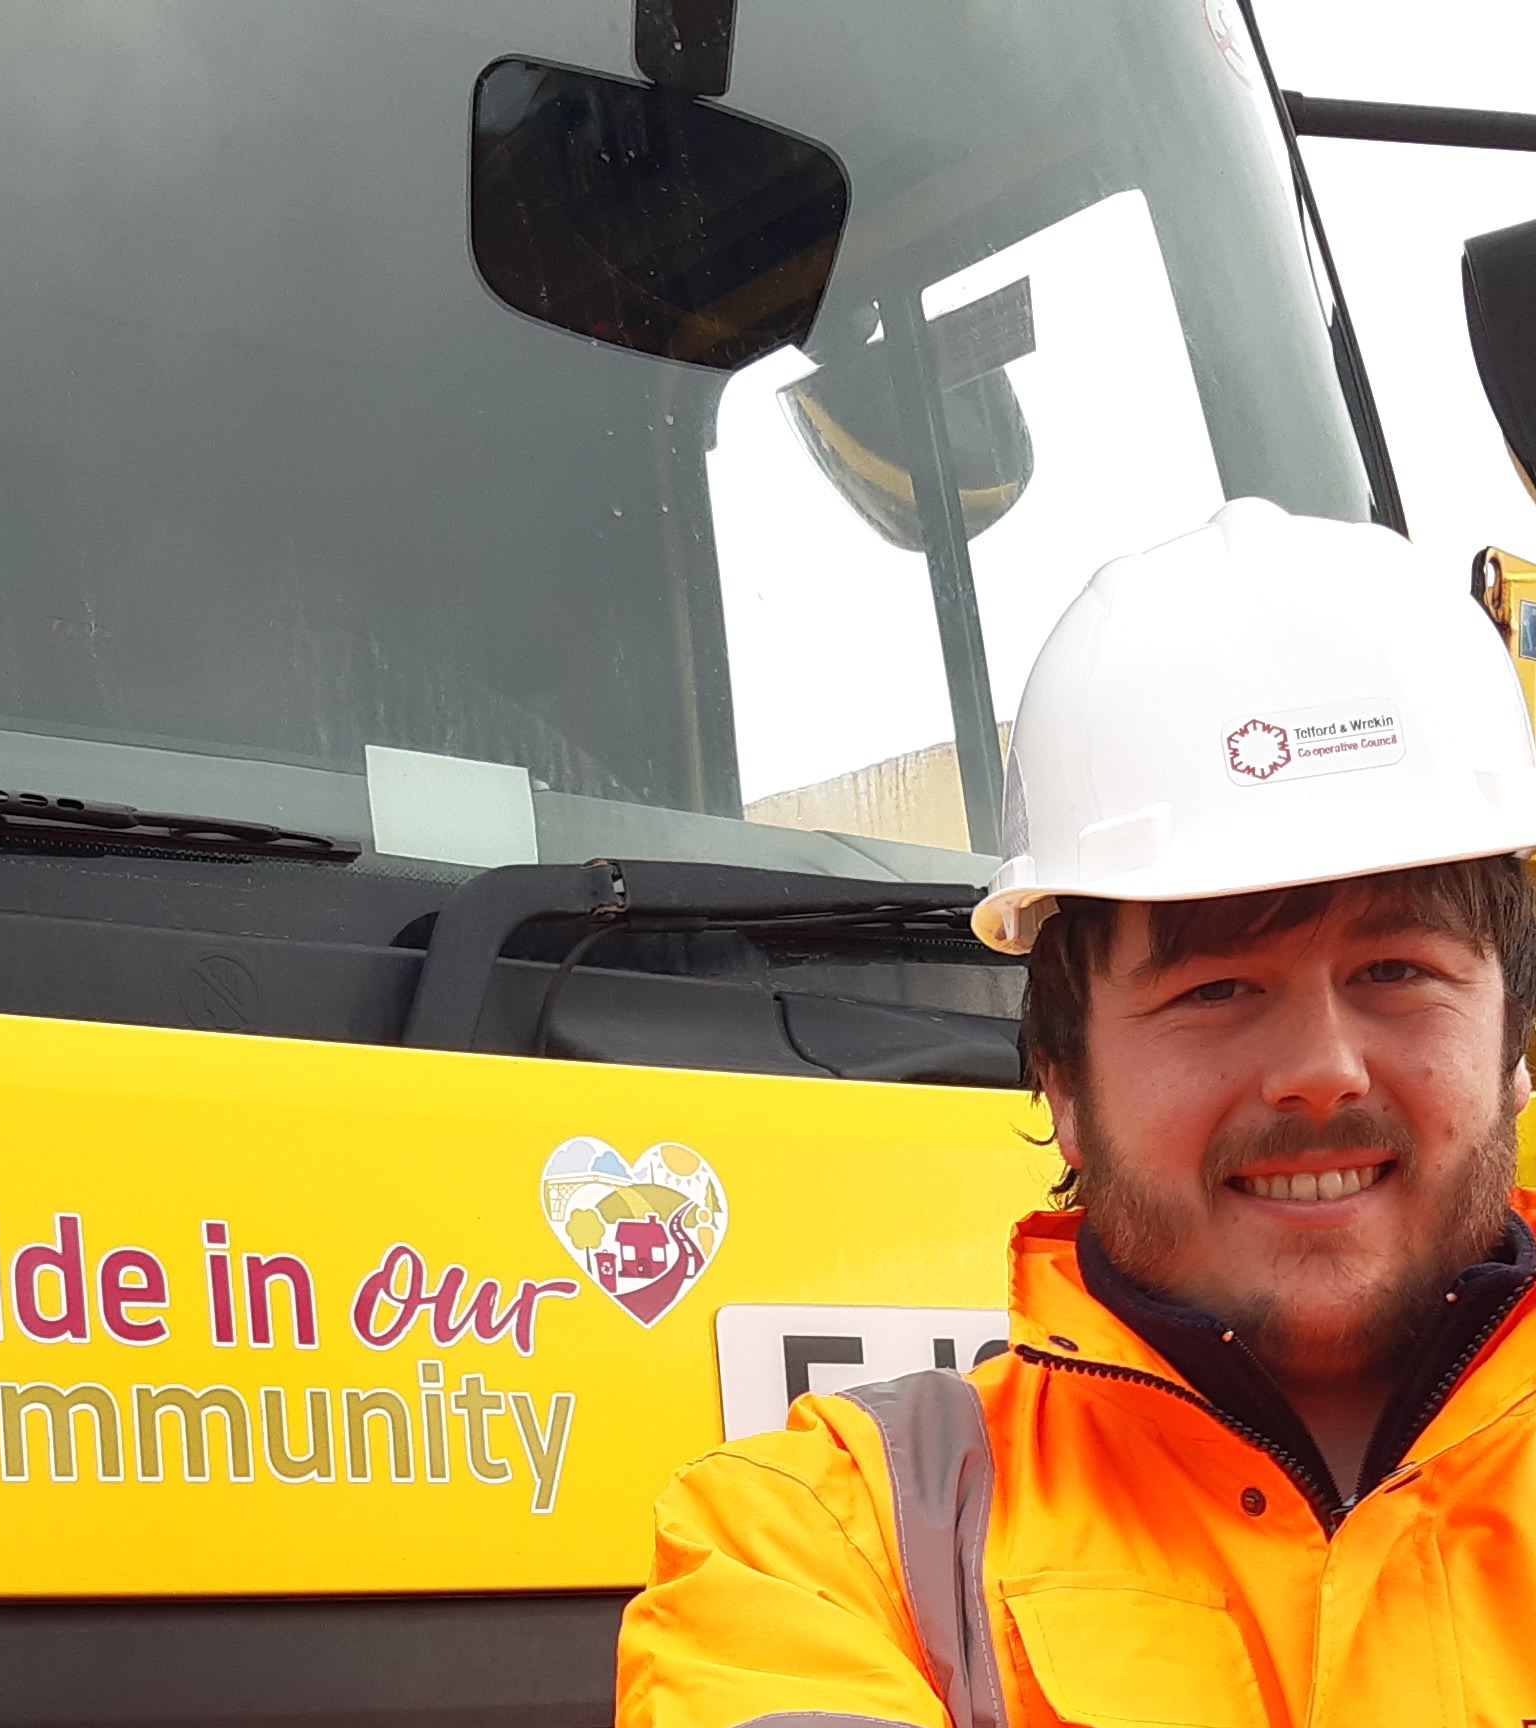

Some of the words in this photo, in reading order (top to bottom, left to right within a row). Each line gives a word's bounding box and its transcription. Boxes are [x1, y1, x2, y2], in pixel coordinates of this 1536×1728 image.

[1340, 723, 1348, 734] &
[1360, 733, 1398, 749] Council
[200, 1219, 320, 1348] in
[350, 1243, 579, 1356] our
